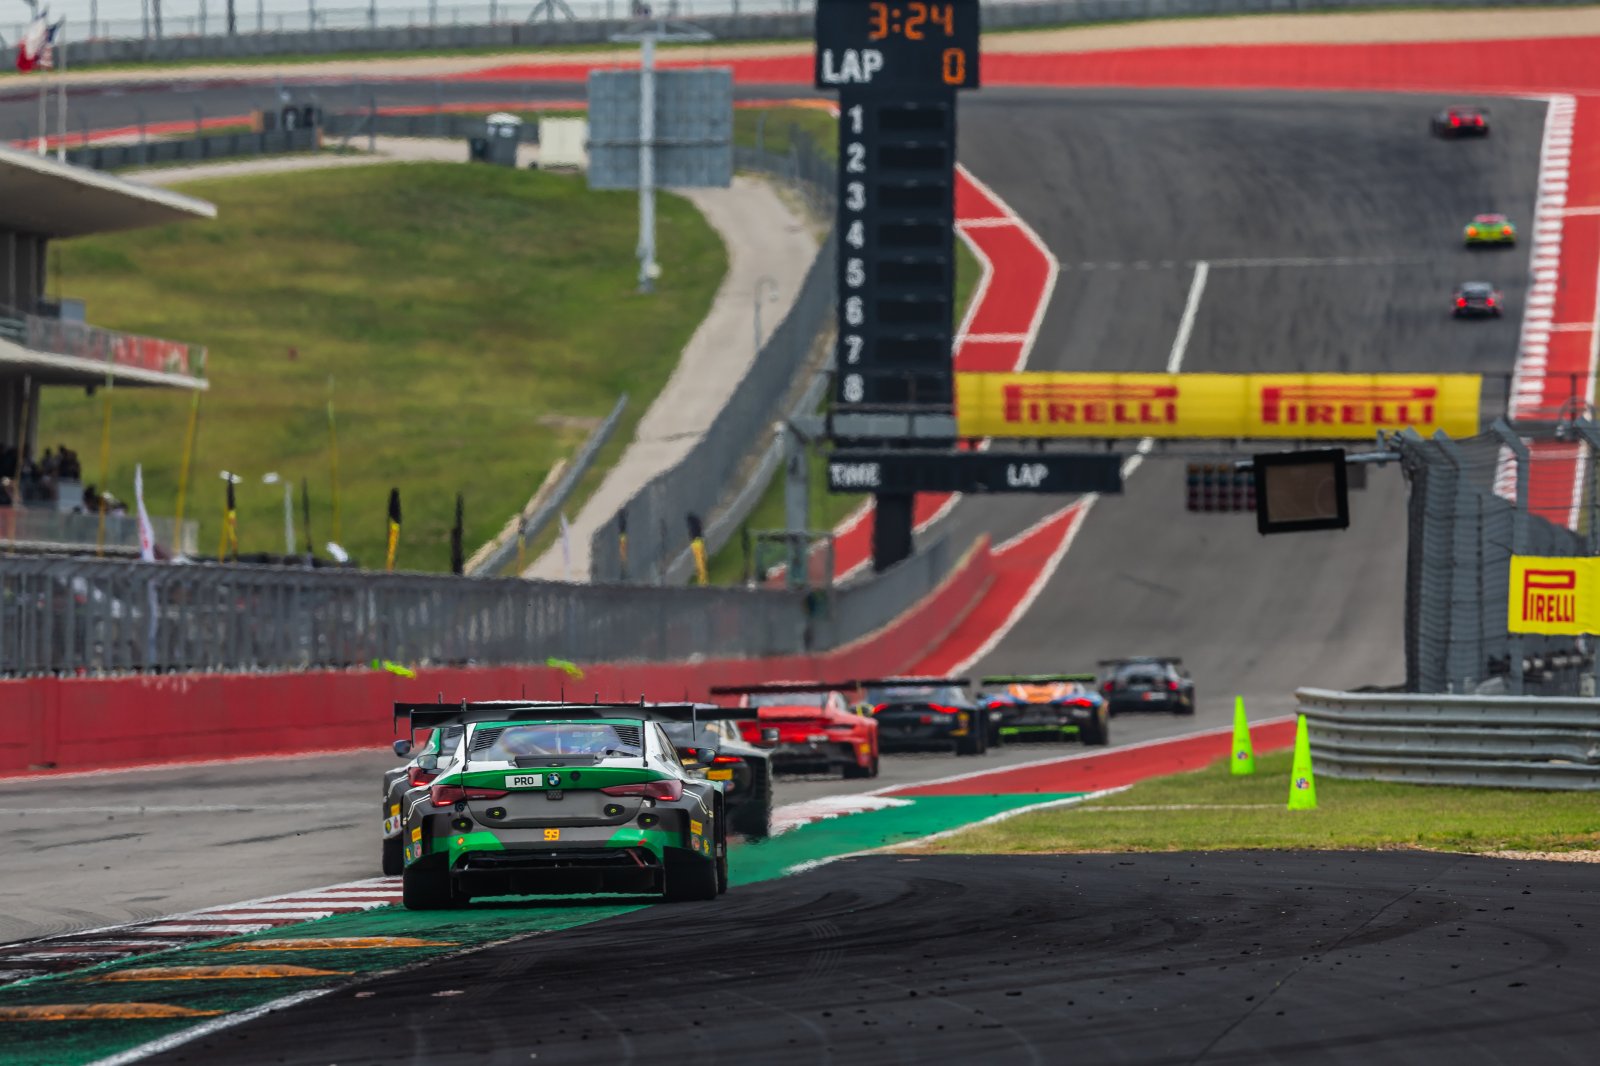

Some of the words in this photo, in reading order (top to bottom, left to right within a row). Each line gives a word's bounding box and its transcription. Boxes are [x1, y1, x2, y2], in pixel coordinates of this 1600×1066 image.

[868, 2, 954, 40] 3:24
[821, 48, 884, 84] LAP
[942, 47, 966, 85] 0
[847, 104, 863, 134] 1
[846, 142, 866, 173] 2
[845, 181, 866, 212] 3
[845, 220, 865, 250] 4
[845, 257, 866, 288] 5
[845, 295, 865, 326] 6
[844, 334, 864, 364] 7
[843, 373, 864, 403] 8
[1002, 383, 1179, 425] PIRELLI
[1260, 384, 1438, 425] PIRELLI
[1006, 463, 1049, 488] LAP
[1522, 569, 1576, 623] PIRELLI
[514, 777, 534, 785] PRO
[543, 828, 560, 841] 99
